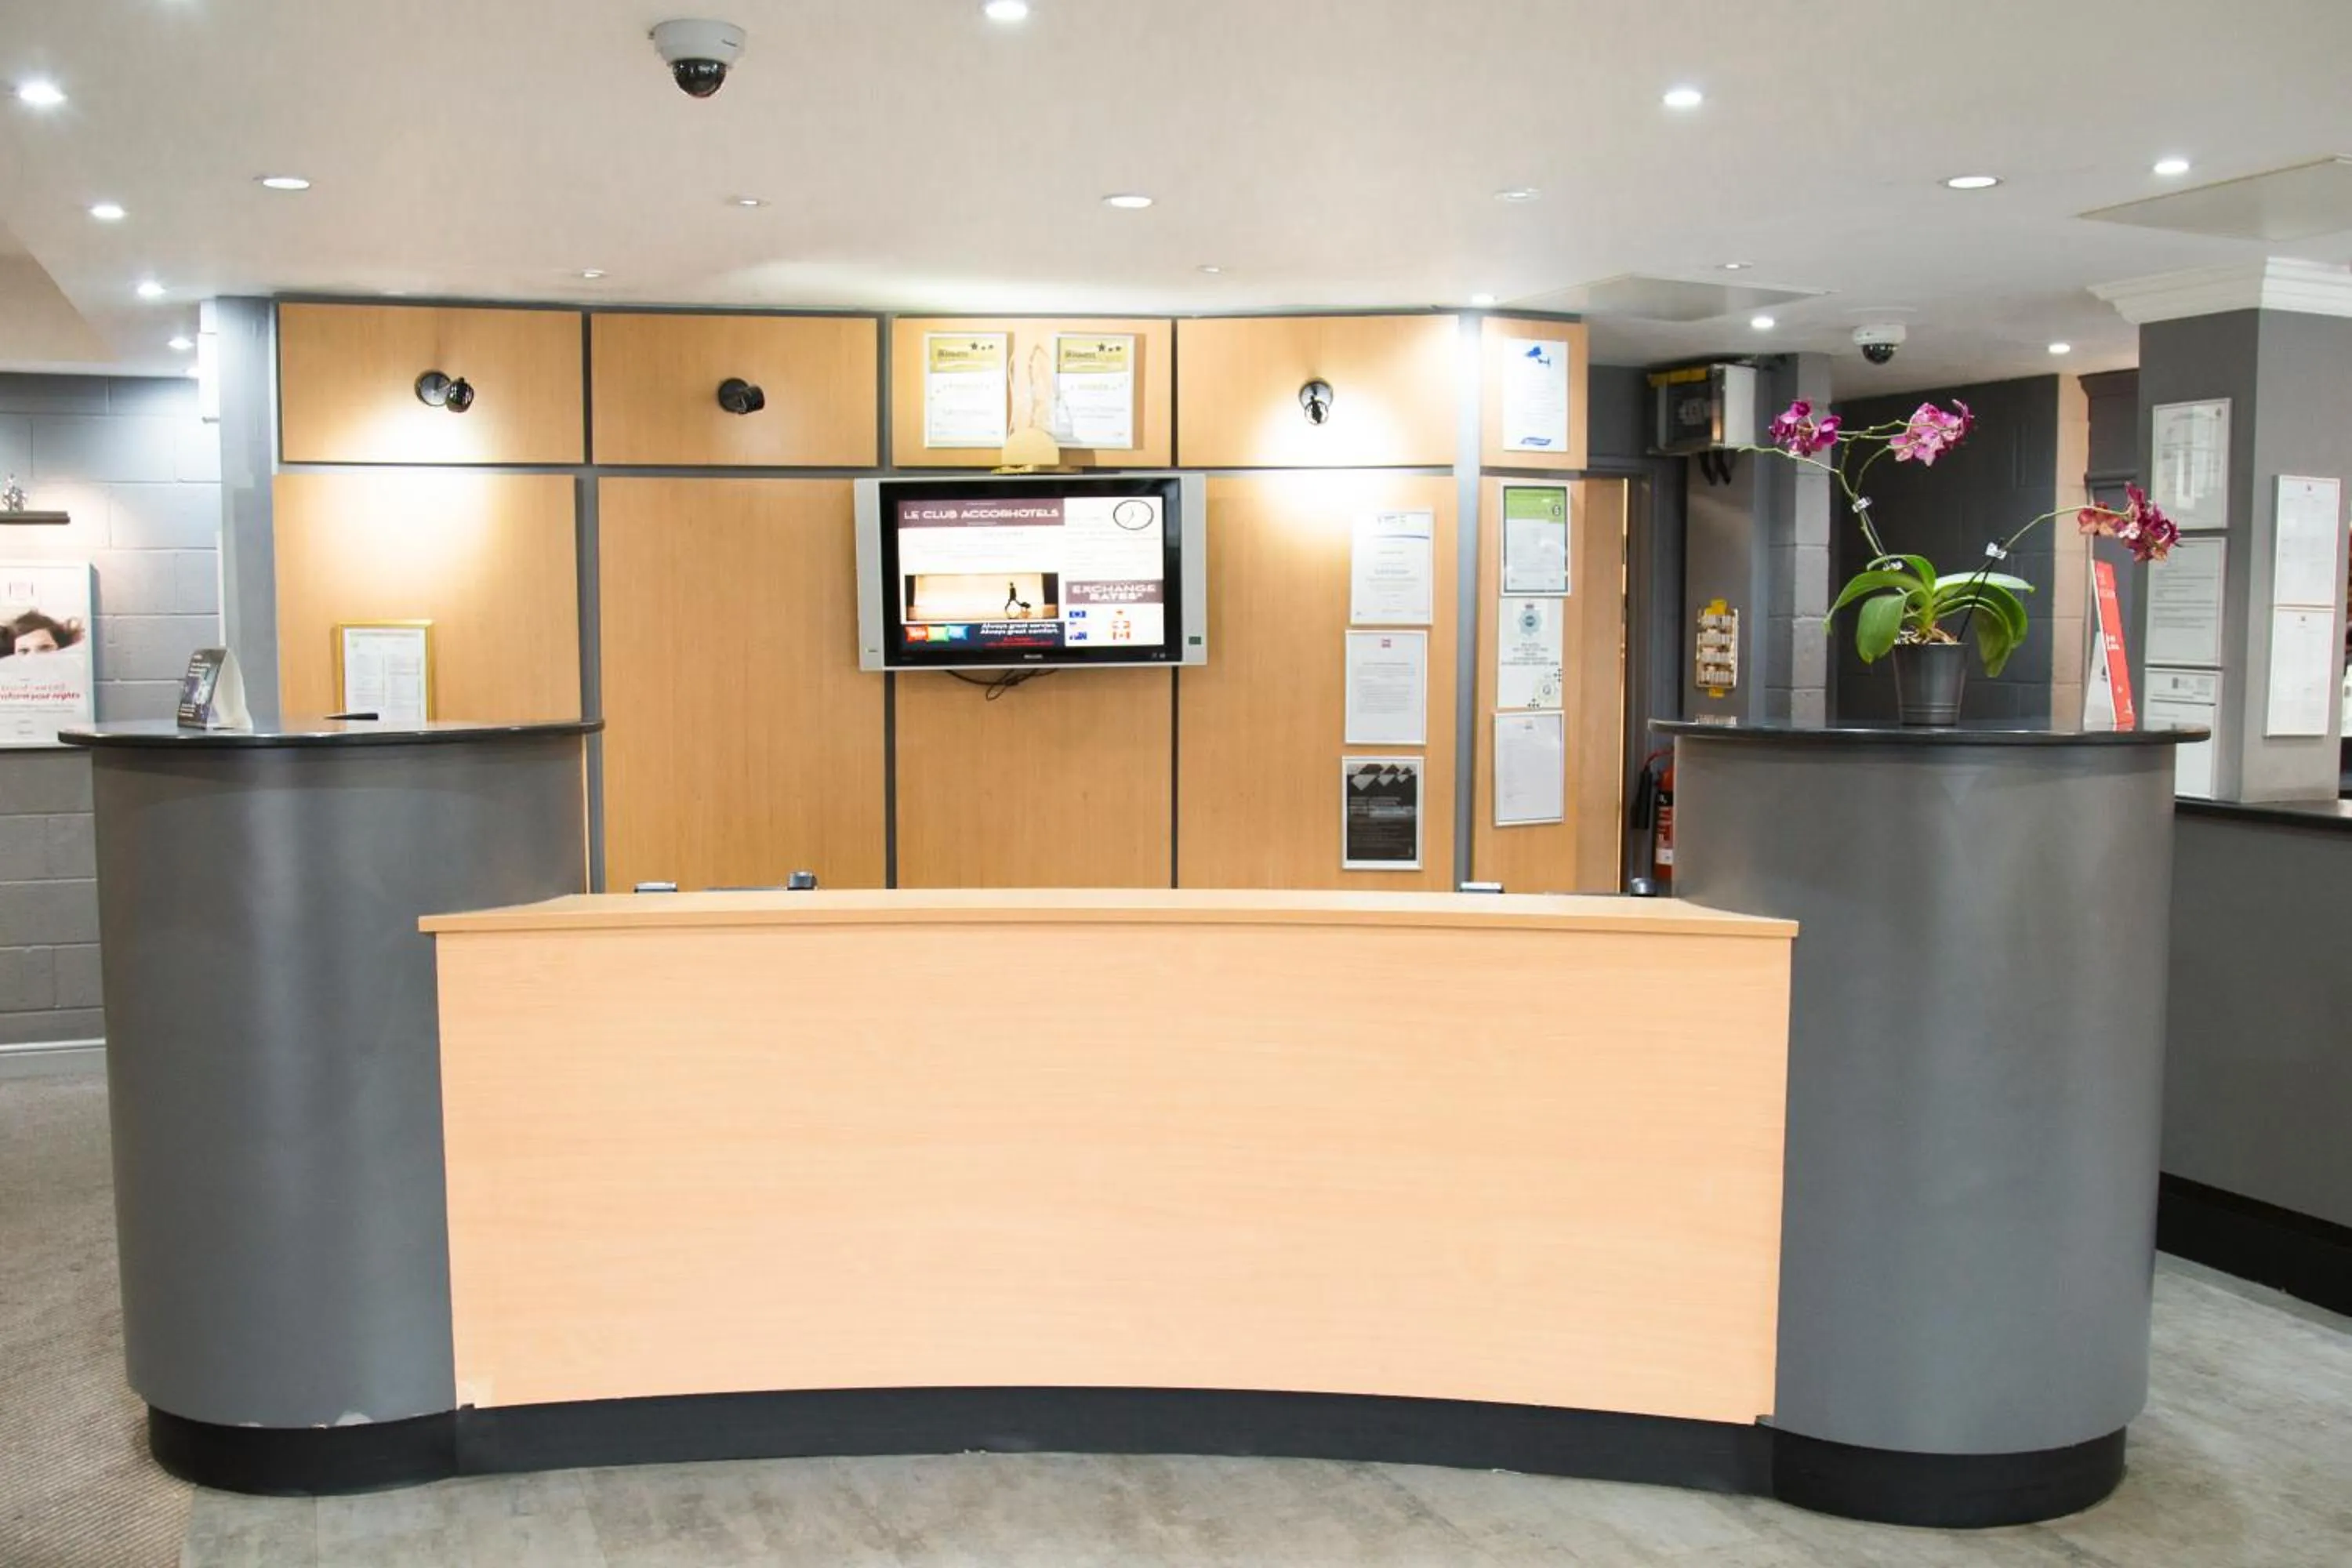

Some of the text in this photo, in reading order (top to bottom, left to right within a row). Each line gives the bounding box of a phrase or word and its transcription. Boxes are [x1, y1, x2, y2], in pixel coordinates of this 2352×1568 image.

[904, 510, 920, 521] LE
[923, 510, 957, 520] CLUB
[1072, 584, 1156, 593] EXCHANGE
